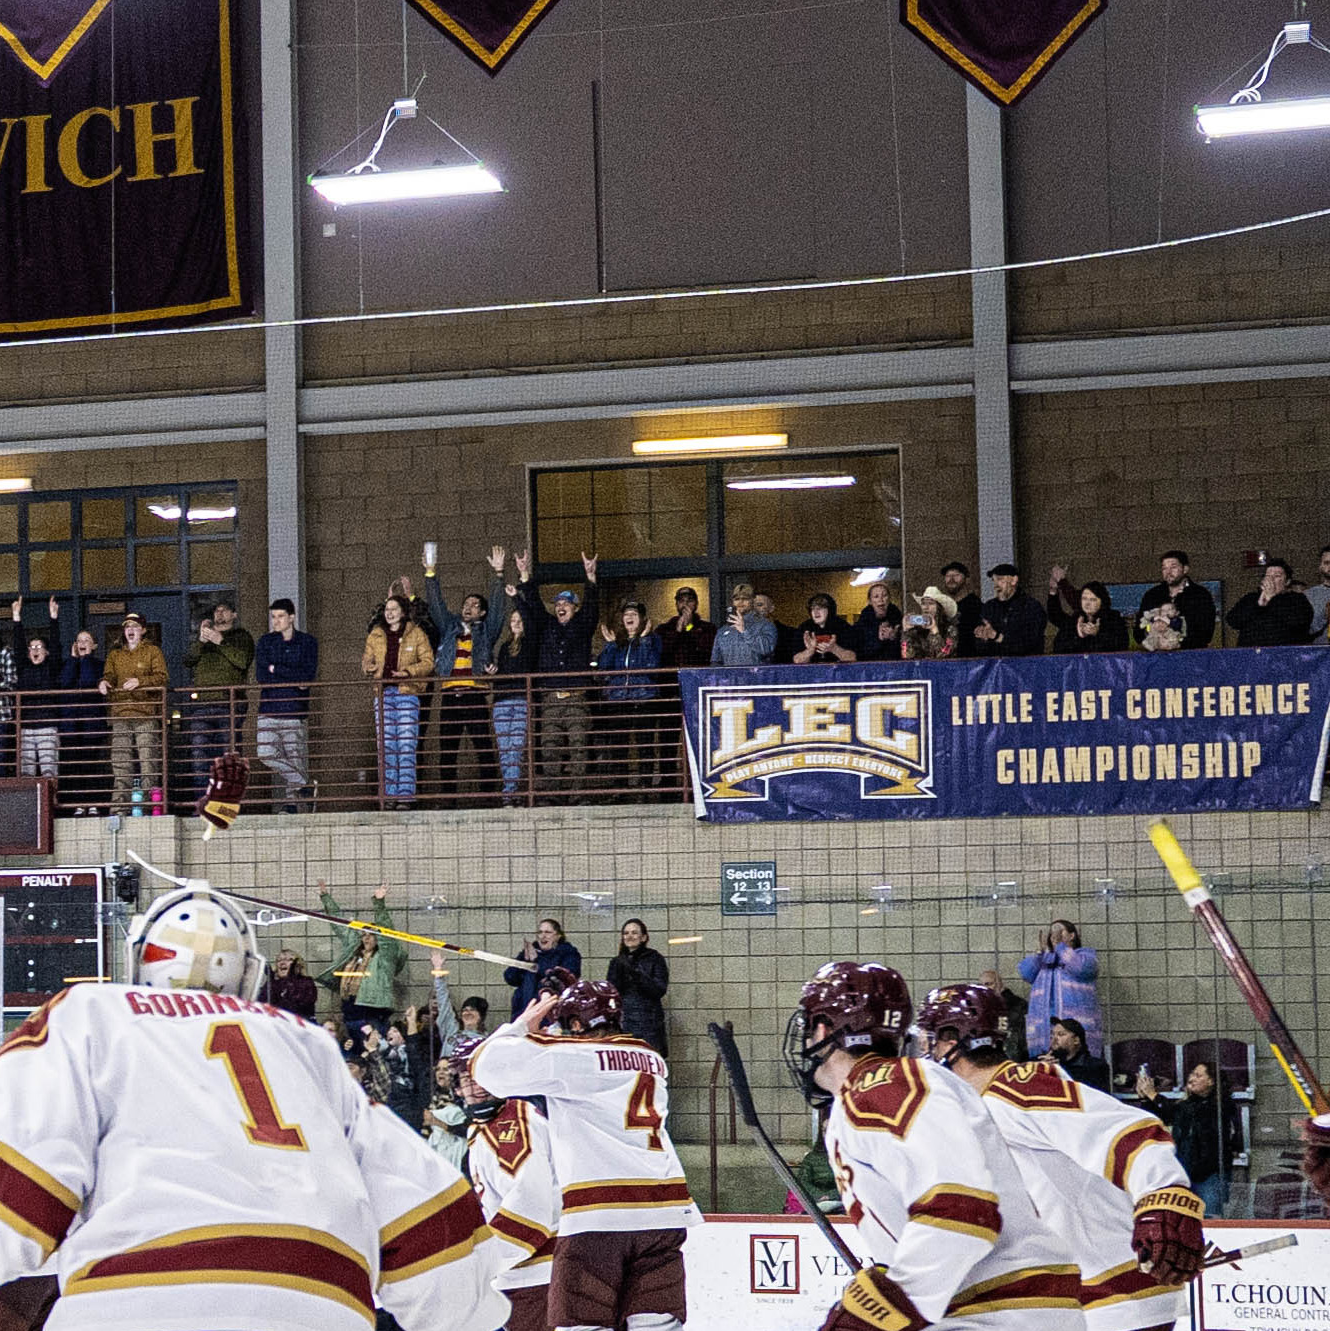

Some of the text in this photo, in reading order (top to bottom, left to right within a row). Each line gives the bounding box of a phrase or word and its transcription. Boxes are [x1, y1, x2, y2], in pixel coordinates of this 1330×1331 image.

[951, 683, 1310, 725] LITTLE EAST CONFERENCE
[712, 693, 919, 761] LEC
[996, 742, 1263, 784] CHAMPIONSHIP
[22, 875, 72, 887] PENALTY
[726, 869, 772, 879] Section
[733, 881, 770, 891] 12 13
[883, 1009, 902, 1027] 12
[203, 1022, 310, 1152] 1
[625, 1070, 665, 1152] 4
[1211, 1284, 1330, 1306] T.CHOUIN
[1234, 1307, 1287, 1320] GENERAL
